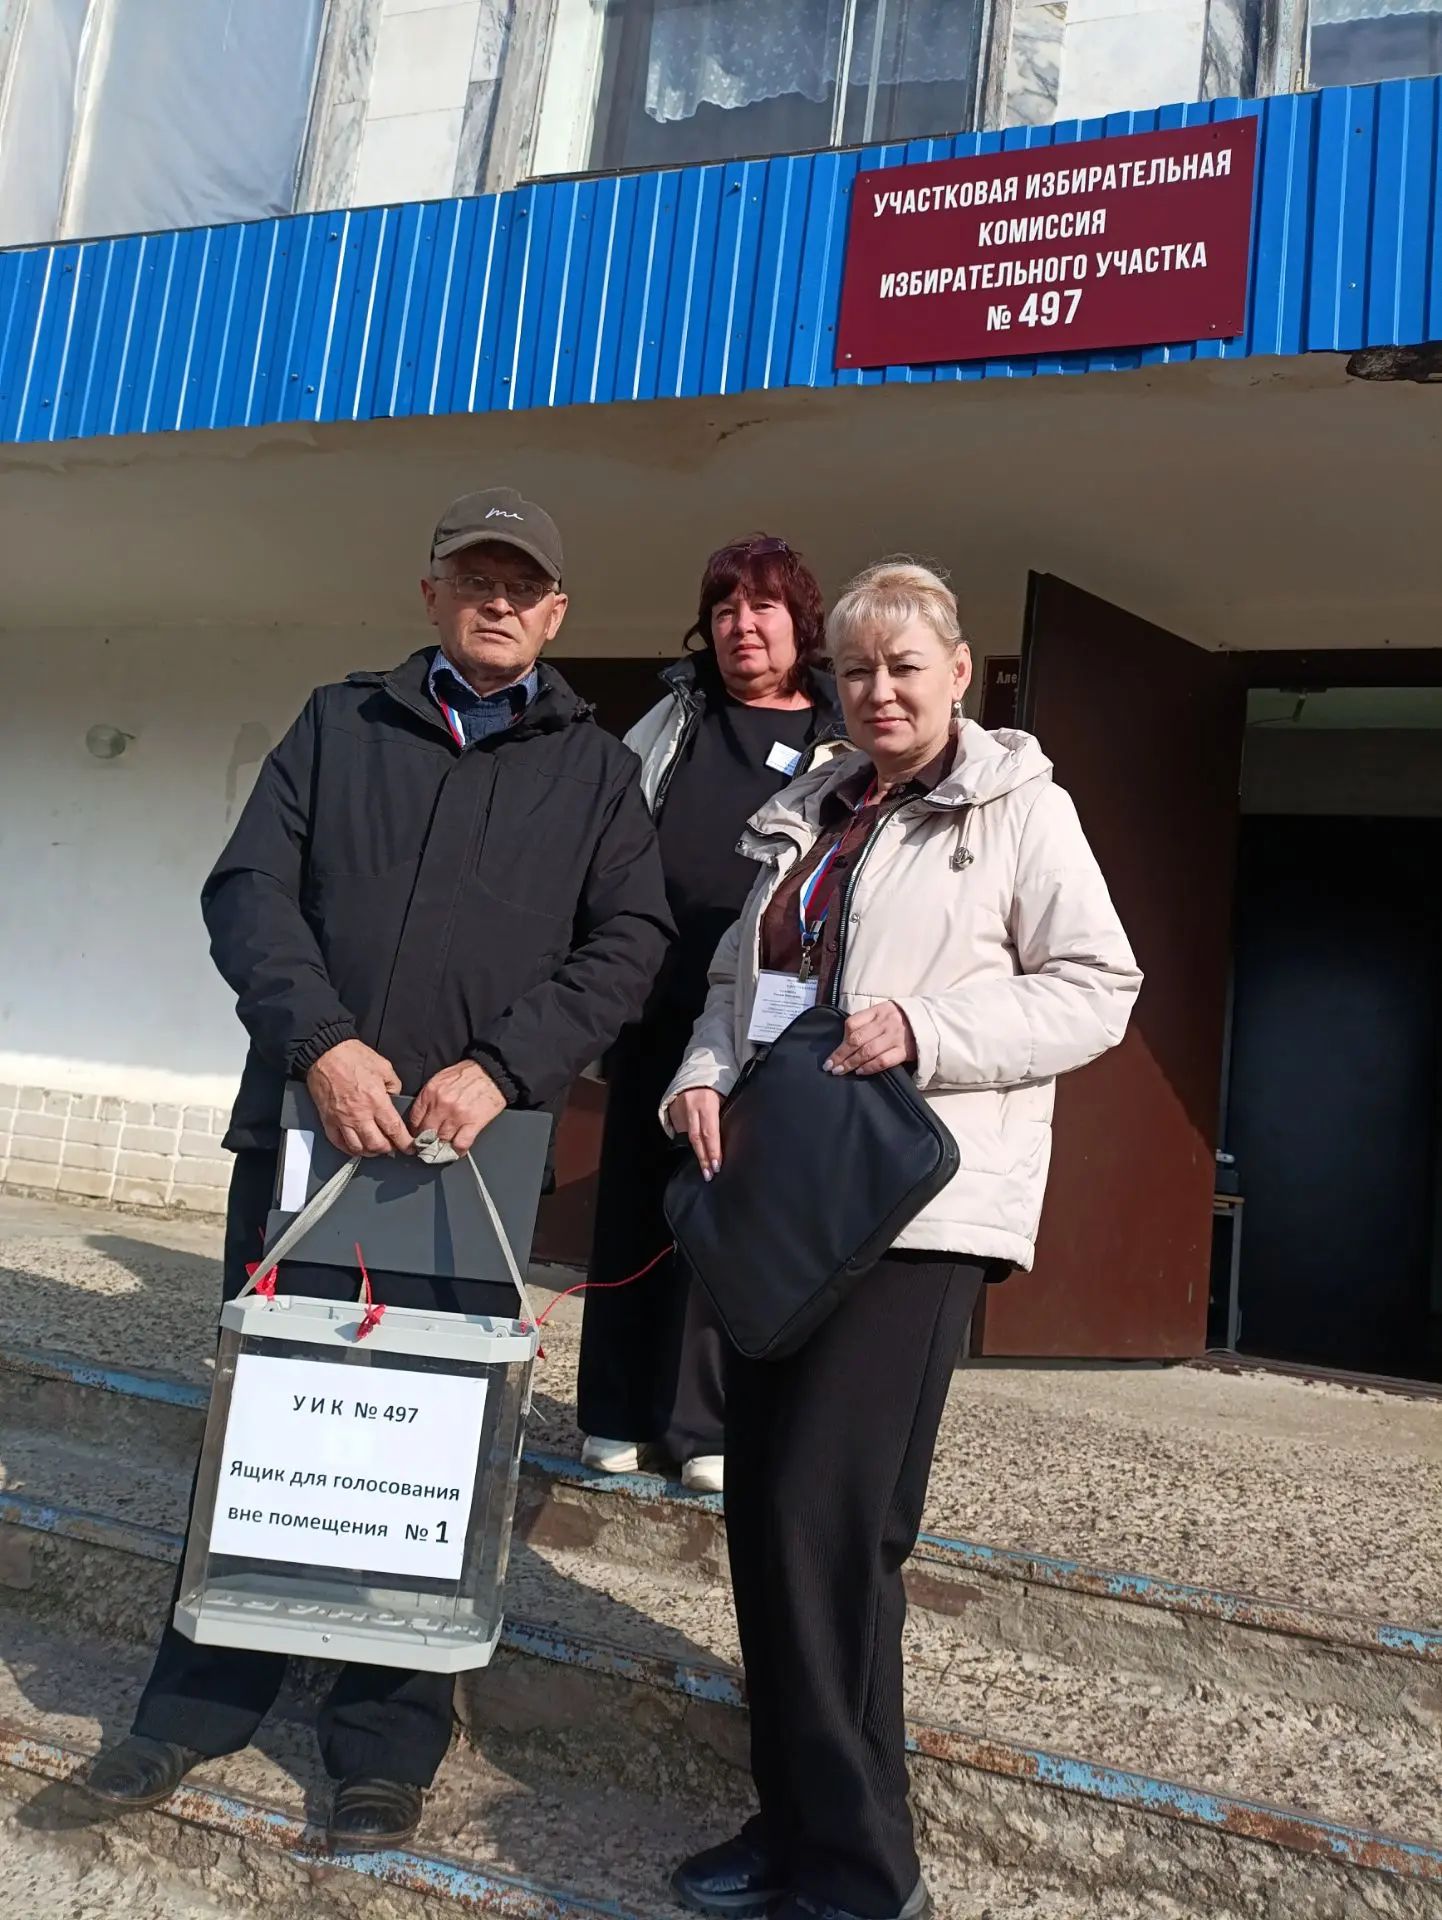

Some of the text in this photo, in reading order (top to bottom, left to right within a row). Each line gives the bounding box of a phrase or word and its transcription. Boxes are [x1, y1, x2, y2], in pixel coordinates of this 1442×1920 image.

[873, 148, 1232, 218] УЧАСТКОВАЯ ИЗБИРАТЕЛЬНАЯ
[978, 208, 1107, 247] КОМИССИЯ
[879, 241, 1208, 298] ИЗБИРАТЕЛЬНОГО УЧАСТКА
[986, 288, 1083, 331] № 497
[996, 671, 1018, 684] Але
[354, 1402, 377, 1420] №
[383, 1405, 419, 1424] 497
[229, 1460, 460, 1501] Ящик для голосования
[228, 1506, 449, 1544] вне помещения № 1
